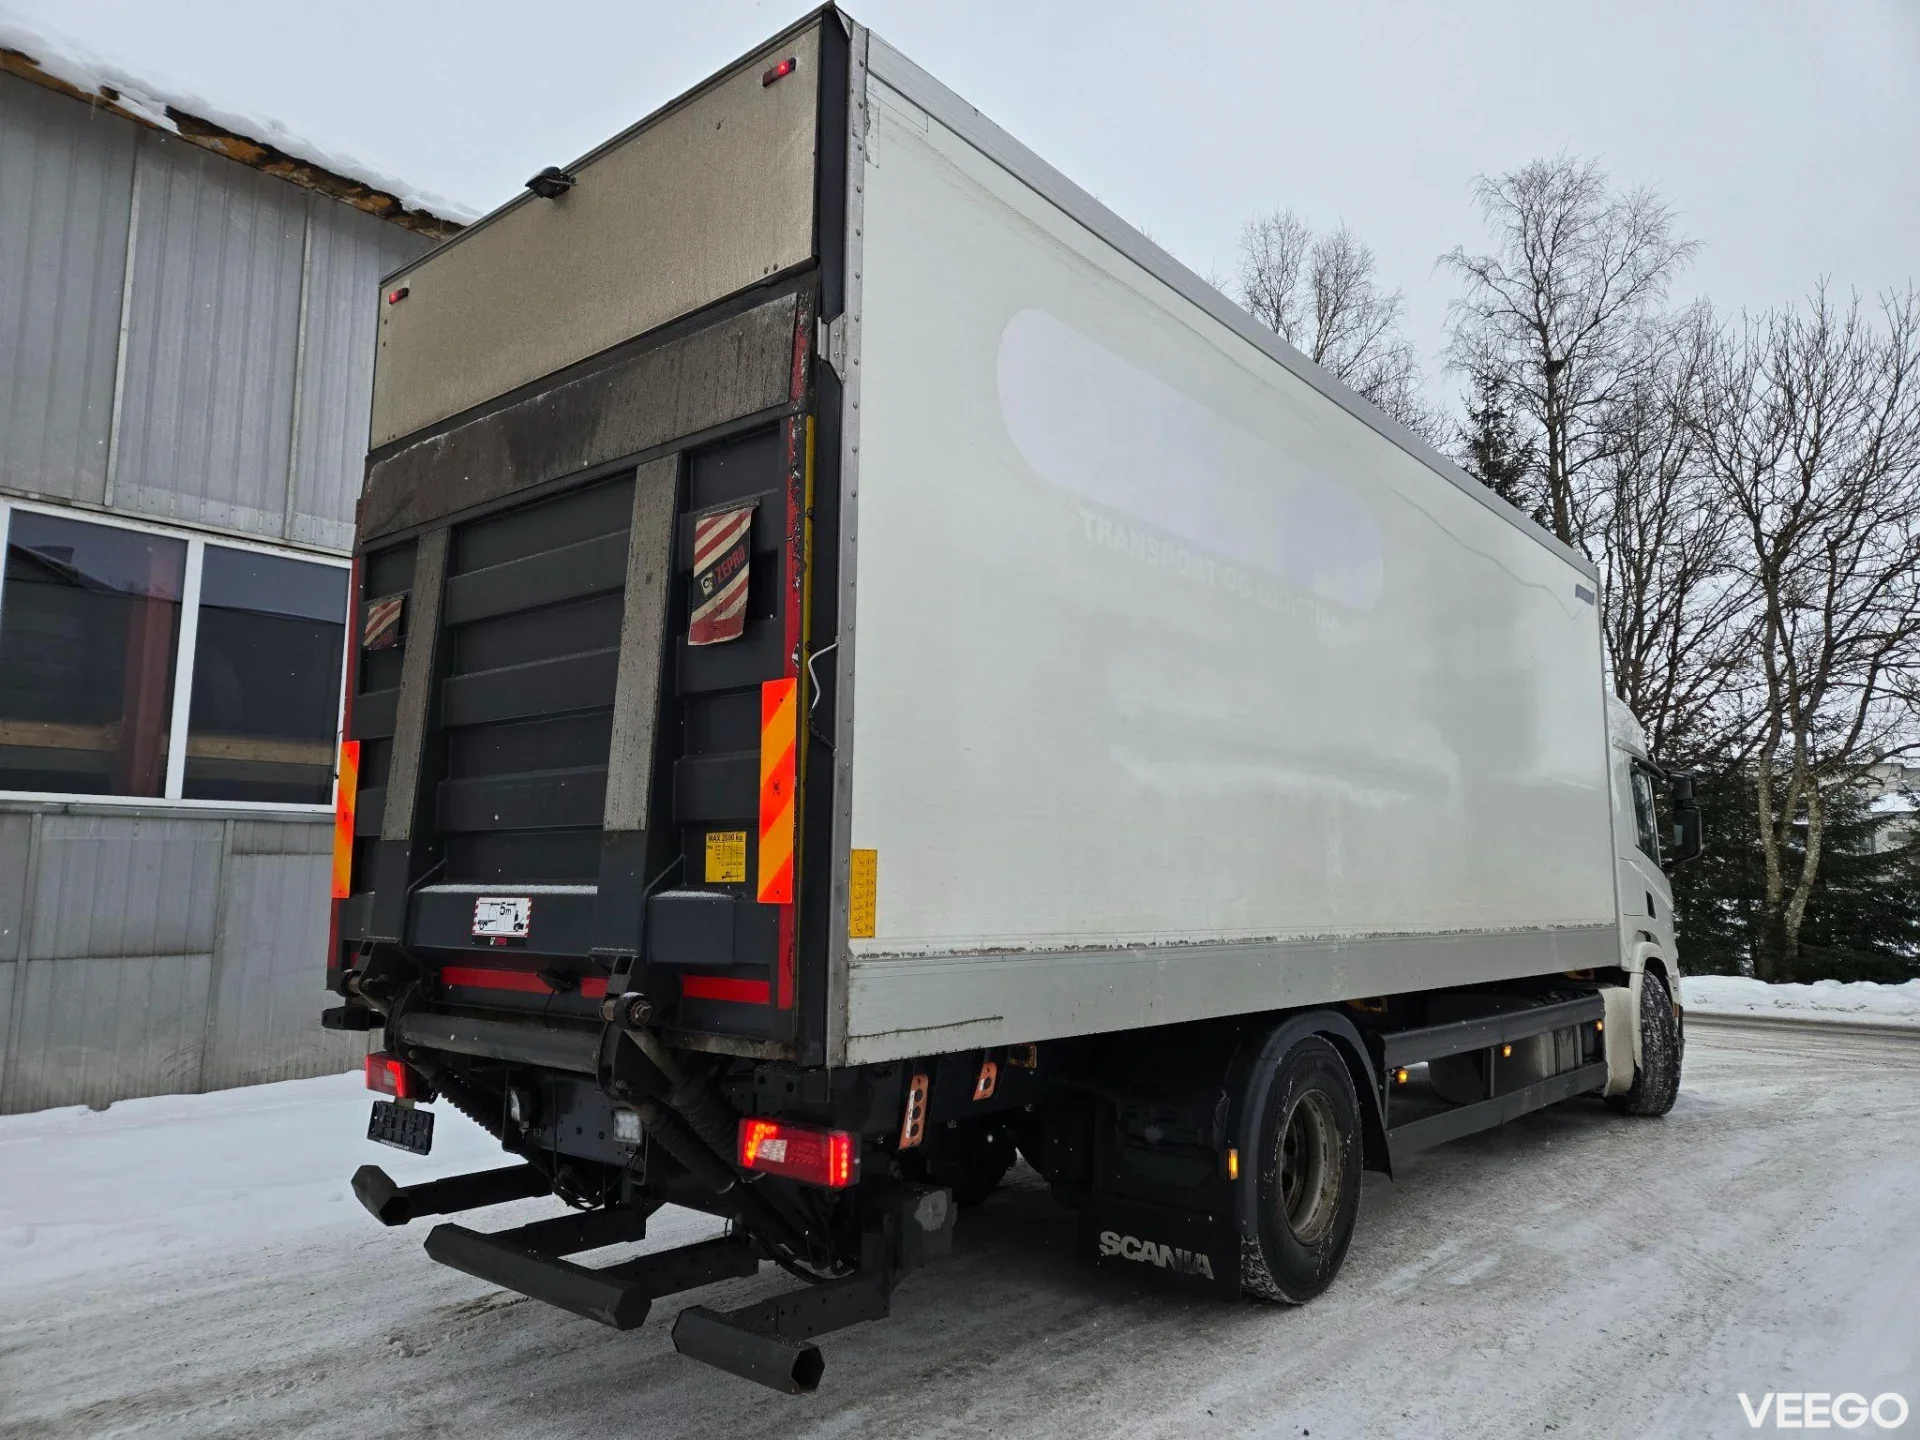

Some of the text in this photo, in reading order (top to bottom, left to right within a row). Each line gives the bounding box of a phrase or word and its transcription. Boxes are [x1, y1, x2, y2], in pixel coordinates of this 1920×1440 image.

[715, 545, 746, 582] ZEPRO
[1080, 508, 1217, 587] TRANSPORT
[1099, 1231, 1214, 1280] SCANIA
